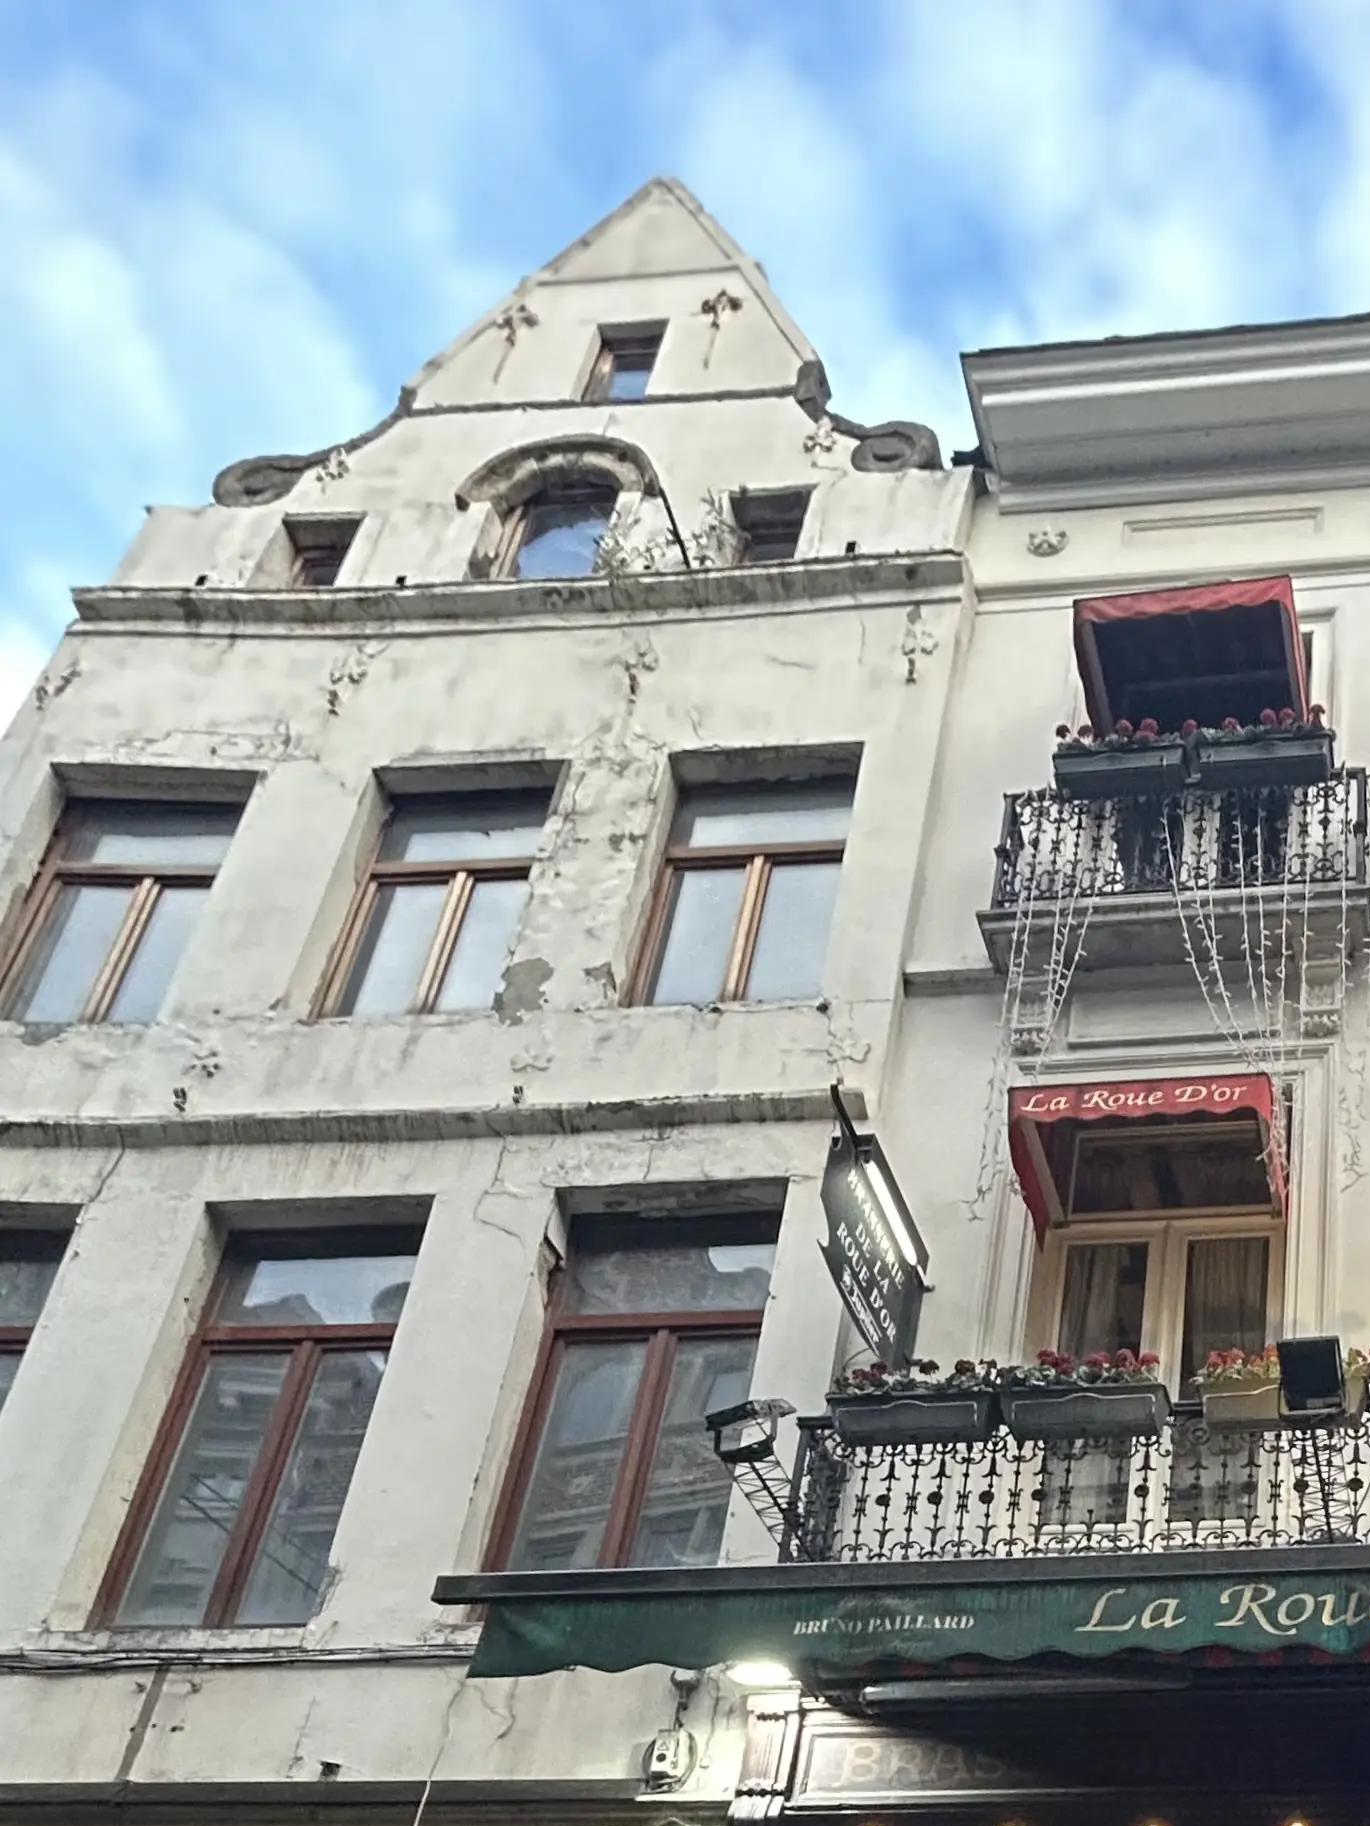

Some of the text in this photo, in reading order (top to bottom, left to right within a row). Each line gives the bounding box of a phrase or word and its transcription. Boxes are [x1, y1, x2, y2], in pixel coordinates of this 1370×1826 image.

[1021, 1084, 1247, 1112] La Roue D'or
[856, 1221, 890, 1295] DE LA
[836, 1220, 896, 1344] ROUE D'OR
[793, 1613, 975, 1636] BRUNO PAILLARD
[1074, 1588, 1187, 1632] La
